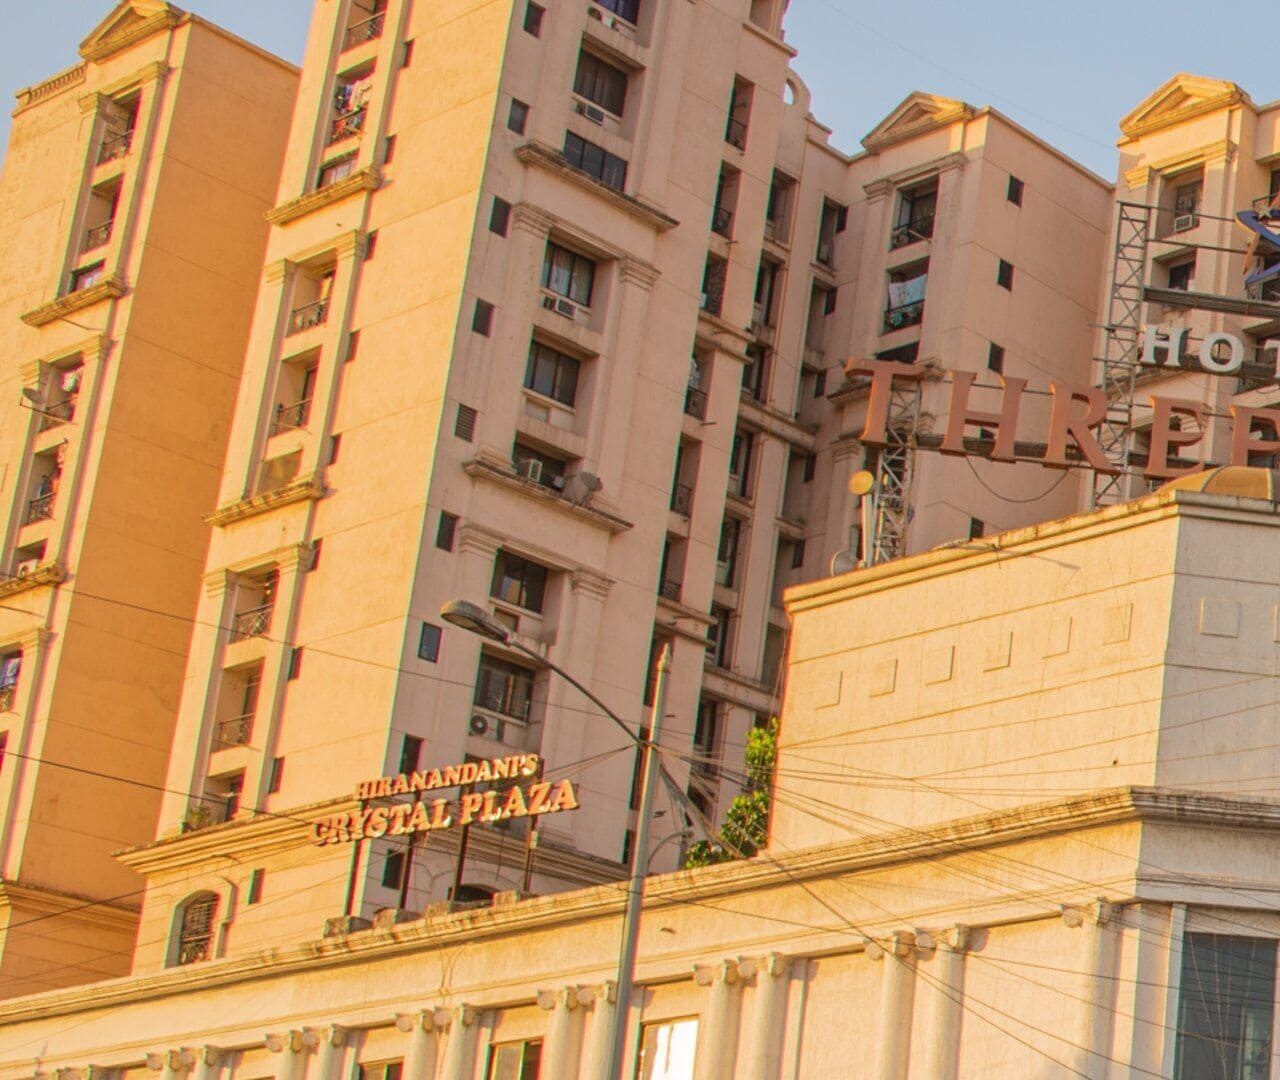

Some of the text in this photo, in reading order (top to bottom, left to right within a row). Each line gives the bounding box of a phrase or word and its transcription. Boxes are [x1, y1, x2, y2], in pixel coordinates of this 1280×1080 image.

[354, 753, 539, 802] HIRANANDANI'S
[309, 778, 579, 847] CRYSTAL PLAZA
